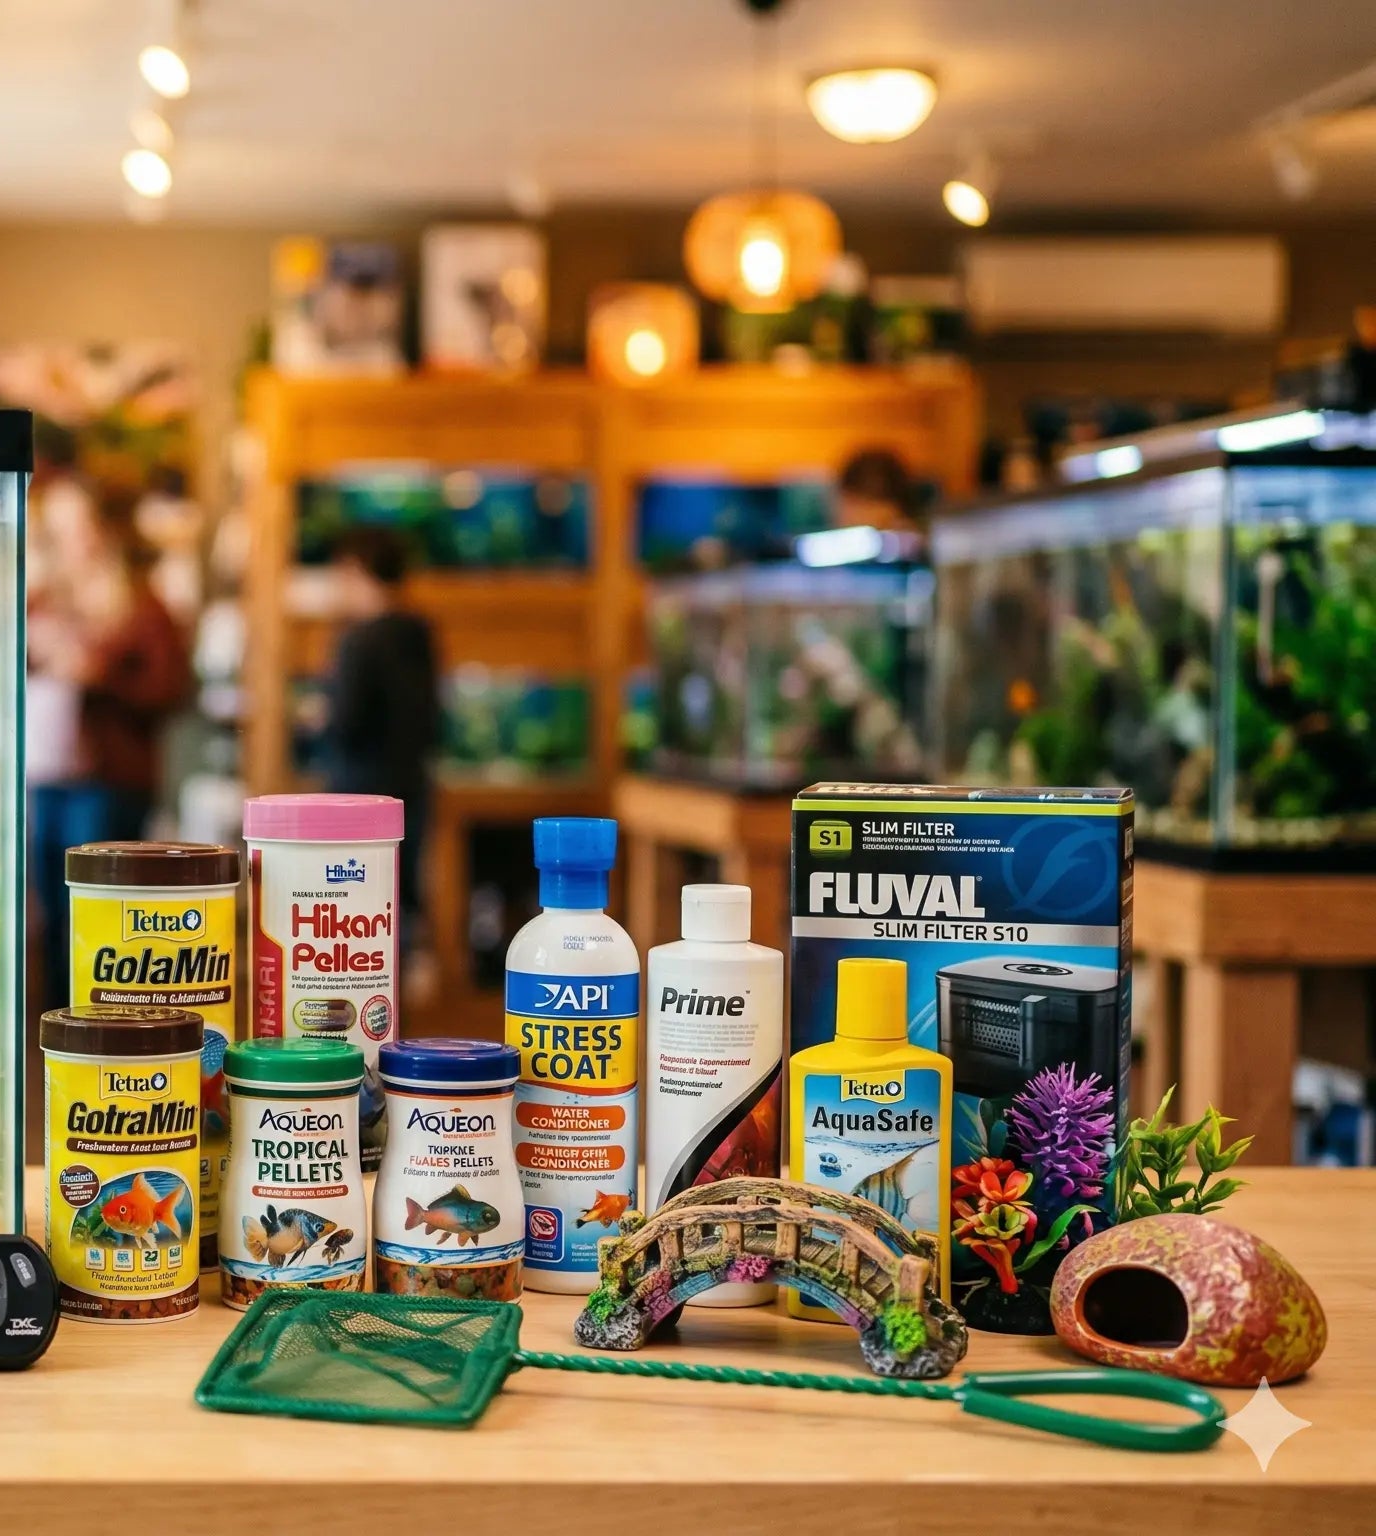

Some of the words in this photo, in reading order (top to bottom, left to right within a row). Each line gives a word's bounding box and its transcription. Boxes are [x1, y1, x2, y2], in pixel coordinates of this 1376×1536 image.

[819, 830, 842, 846] S1
[862, 822, 898, 835] SLIM
[903, 822, 955, 836] FILTER
[809, 872, 985, 918] FLUVAL
[127, 909, 183, 932] Tetra
[291, 901, 391, 939] Hikari
[873, 922, 918, 939] SLIM
[924, 924, 987, 941] FILTER
[993, 926, 1028, 942] S10
[93, 944, 231, 985] GolaMin
[291, 942, 384, 973] Pelles
[553, 985, 608, 1011] API
[660, 986, 745, 1017] Prime
[521, 1022, 622, 1052] STRESS
[531, 1053, 611, 1080] COAT
[104, 1072, 151, 1093] Tetra
[844, 1079, 884, 1096] Tetra
[531, 1117, 610, 1129] CONDITIONER
[551, 1108, 590, 1119] WATER
[812, 1106, 933, 1136] AquaSafe
[251, 1139, 349, 1160] TROPICAL
[258, 1161, 343, 1183] PELLETS
[453, 1156, 494, 1168] PELLETS
